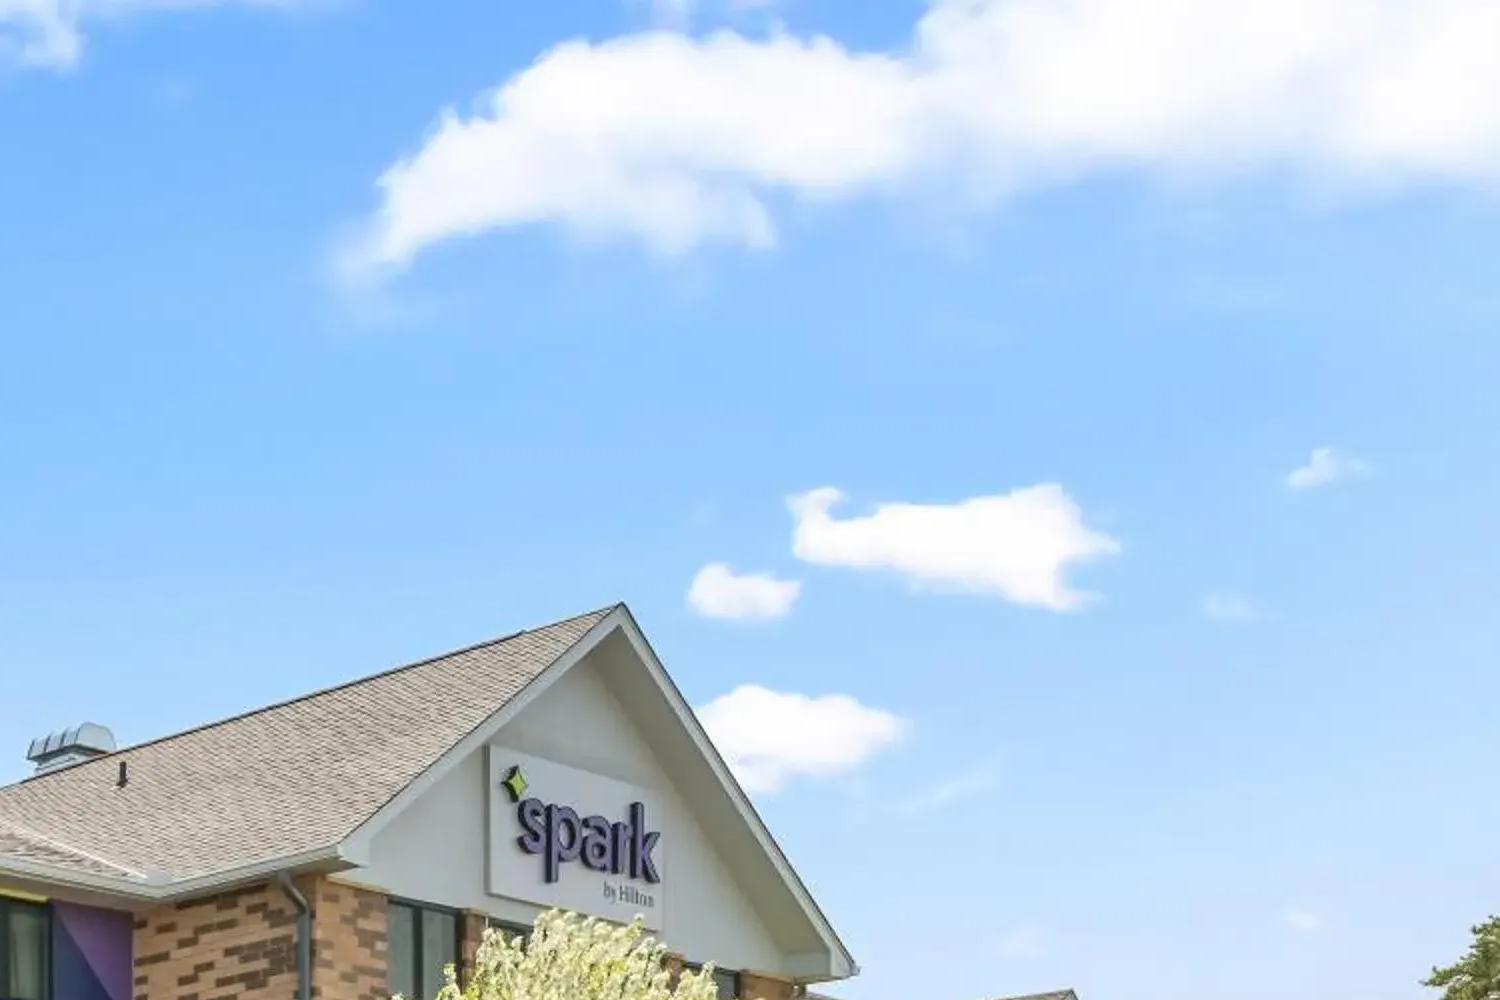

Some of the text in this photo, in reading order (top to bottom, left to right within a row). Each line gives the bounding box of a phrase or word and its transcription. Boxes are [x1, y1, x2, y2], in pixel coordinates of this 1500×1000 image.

[517, 798, 660, 883] spark
[603, 881, 654, 907] by Hilton
